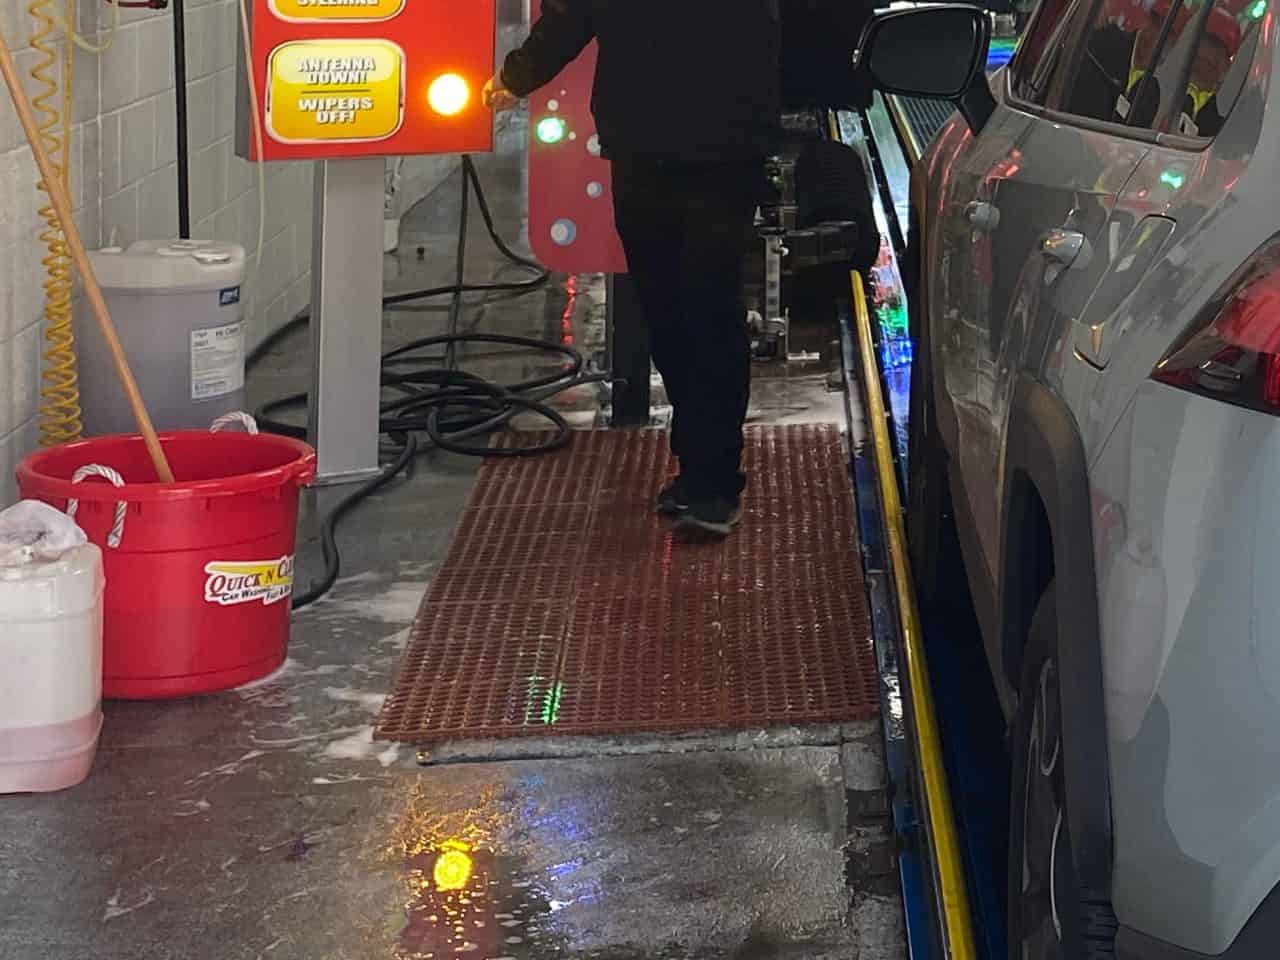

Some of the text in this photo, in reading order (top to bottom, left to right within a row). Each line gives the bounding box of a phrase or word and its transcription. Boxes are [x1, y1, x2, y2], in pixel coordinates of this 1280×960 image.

[298, 57, 377, 72] ANTENNA
[307, 71, 368, 85] DOWN!
[298, 98, 374, 112] WIPERS
[316, 111, 357, 125] OFF!
[208, 572, 262, 597] QUICK
